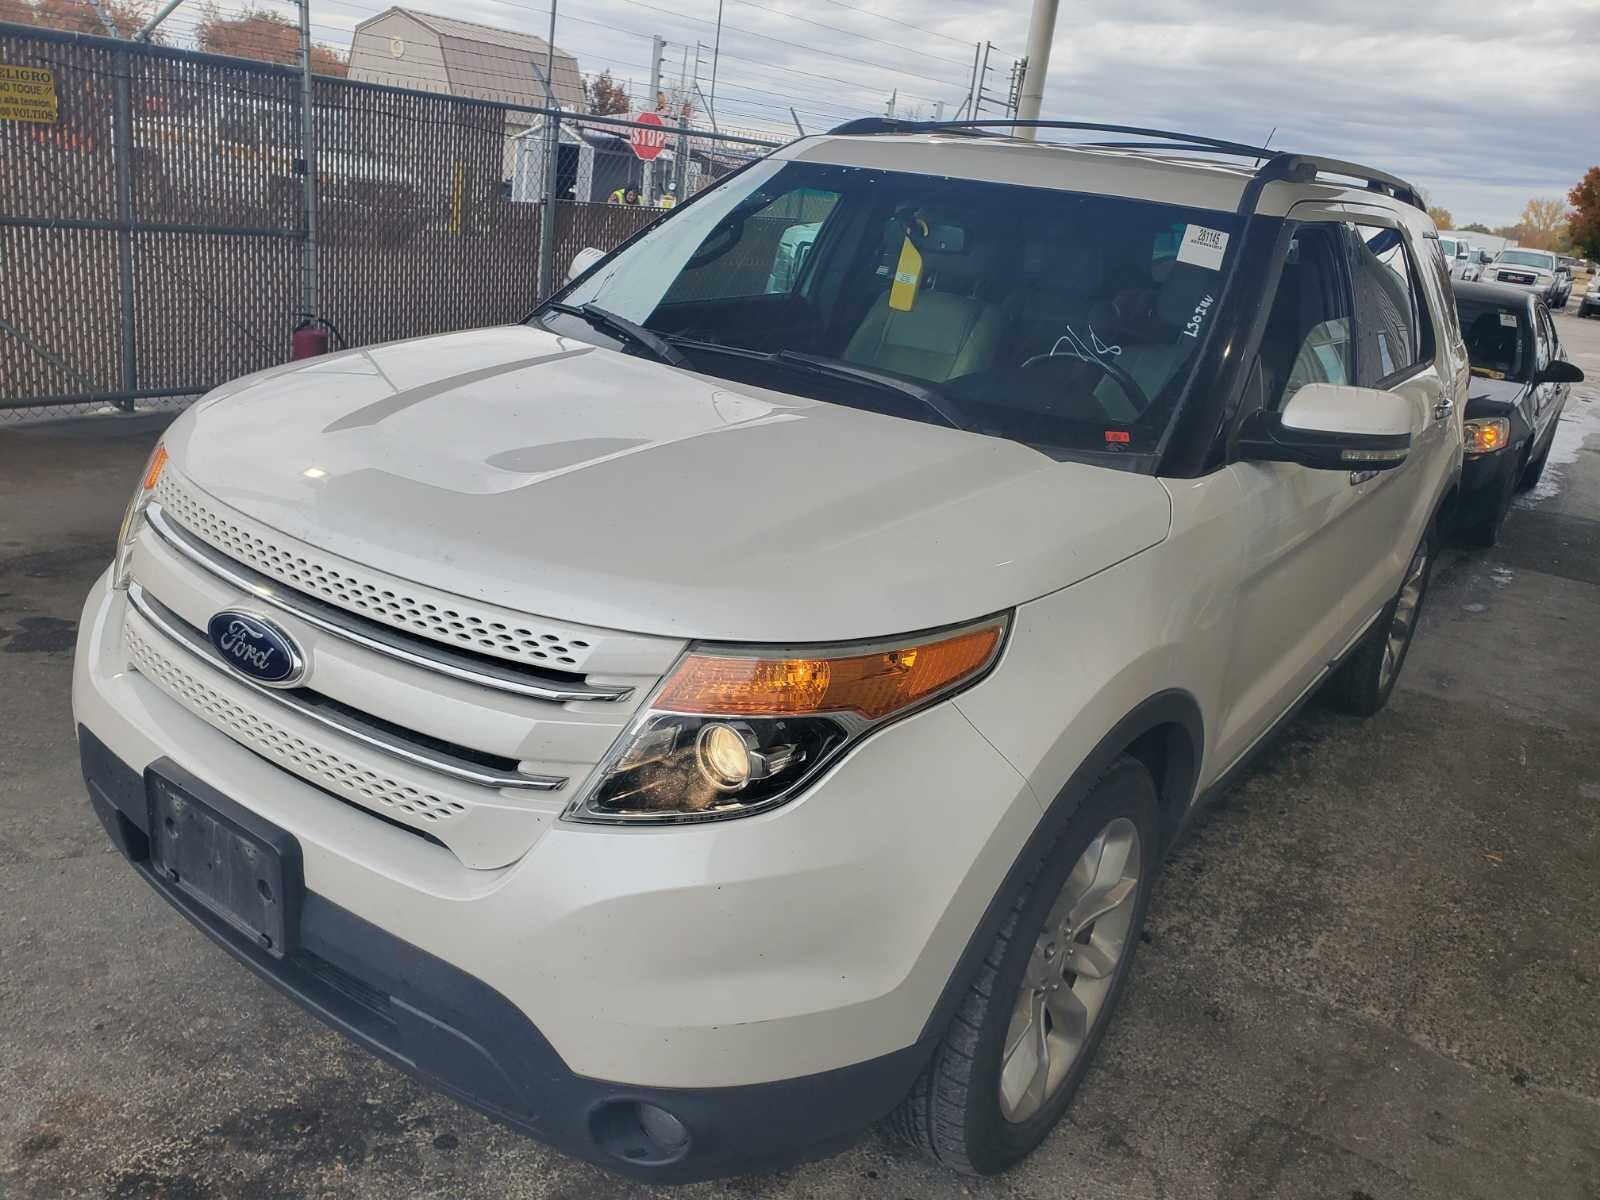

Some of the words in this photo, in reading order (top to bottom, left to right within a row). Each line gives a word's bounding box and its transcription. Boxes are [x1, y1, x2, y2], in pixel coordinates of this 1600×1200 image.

[12, 107, 54, 120] VOLTIOS
[632, 128, 665, 148] STOP
[220, 620, 275, 669] Ford
